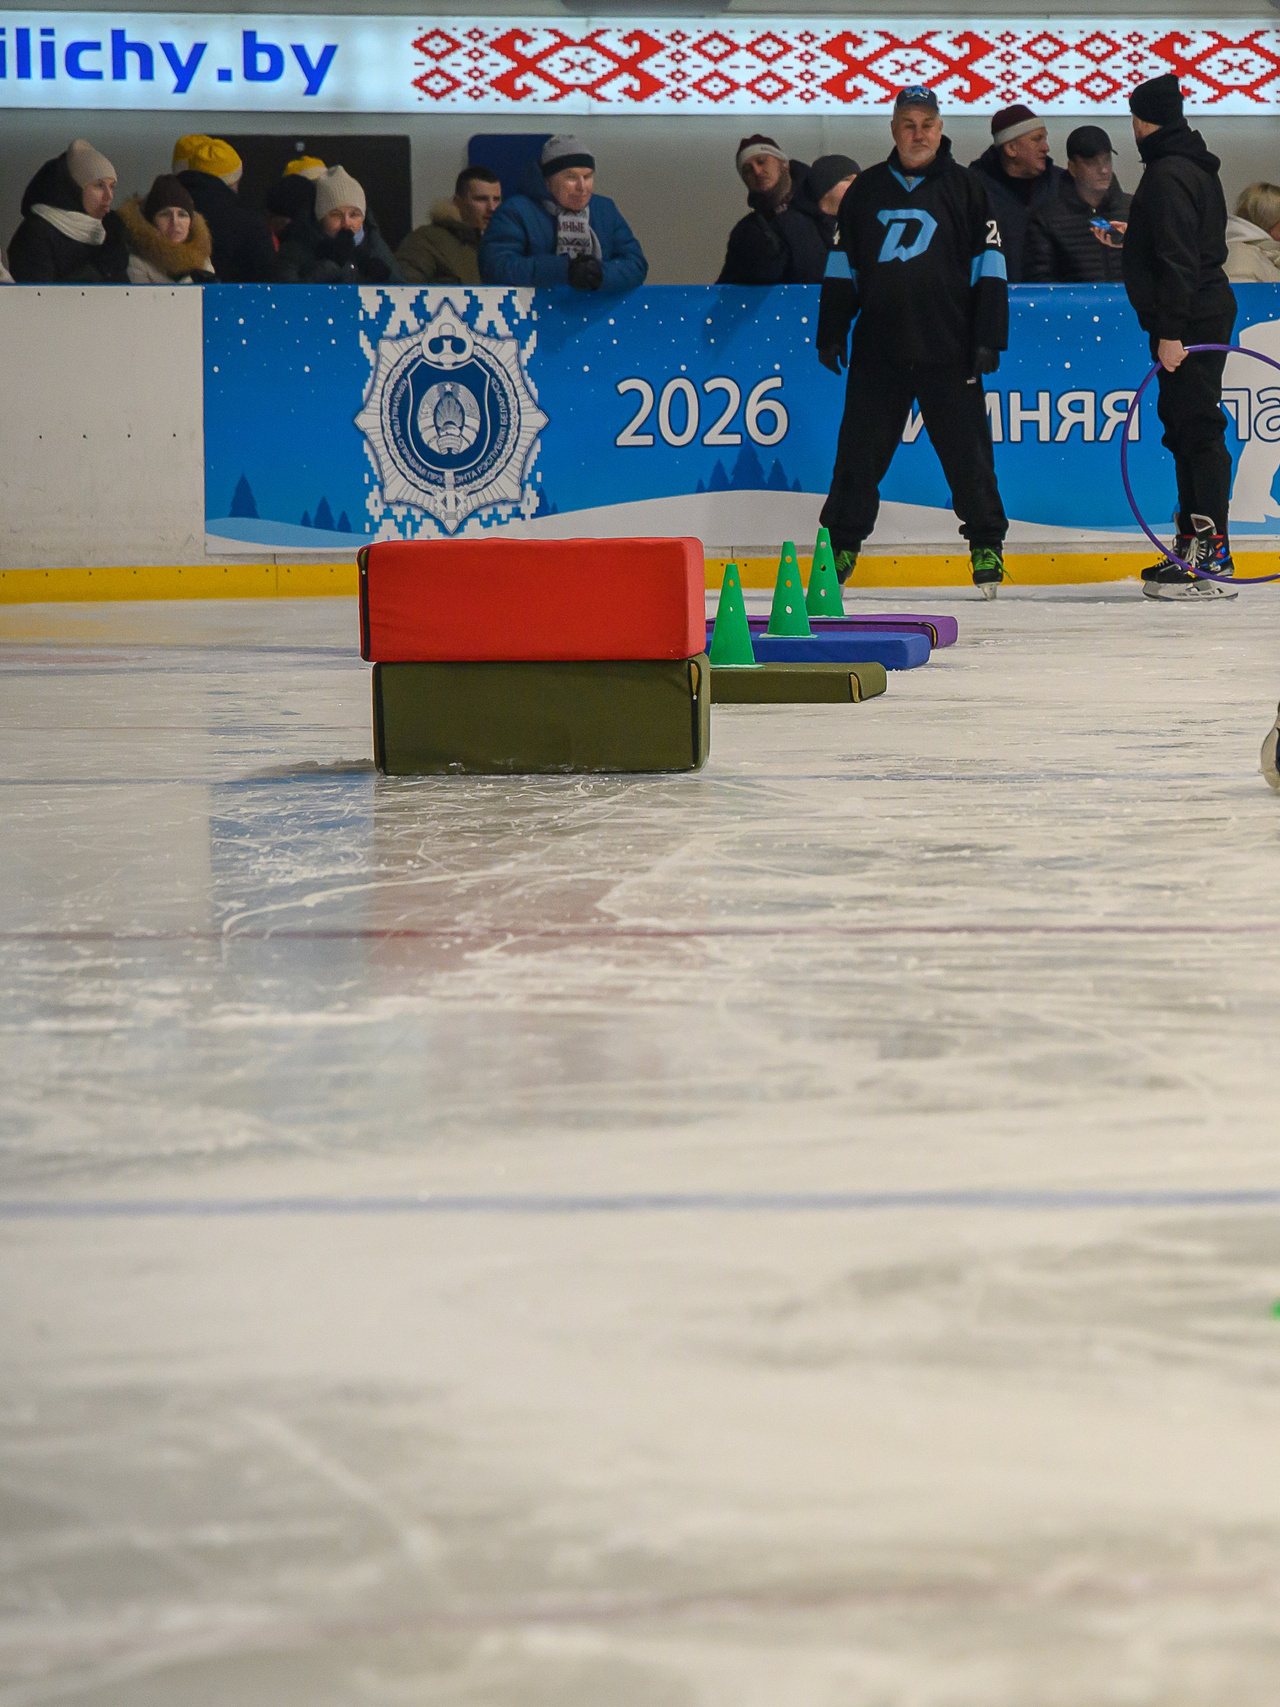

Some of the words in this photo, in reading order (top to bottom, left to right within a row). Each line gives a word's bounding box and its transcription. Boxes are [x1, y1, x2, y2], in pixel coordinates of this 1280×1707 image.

[490, 377, 508, 425] БЕЛАРУСЬ
[615, 376, 789, 447] 2026
[902, 390, 1141, 443] няя
